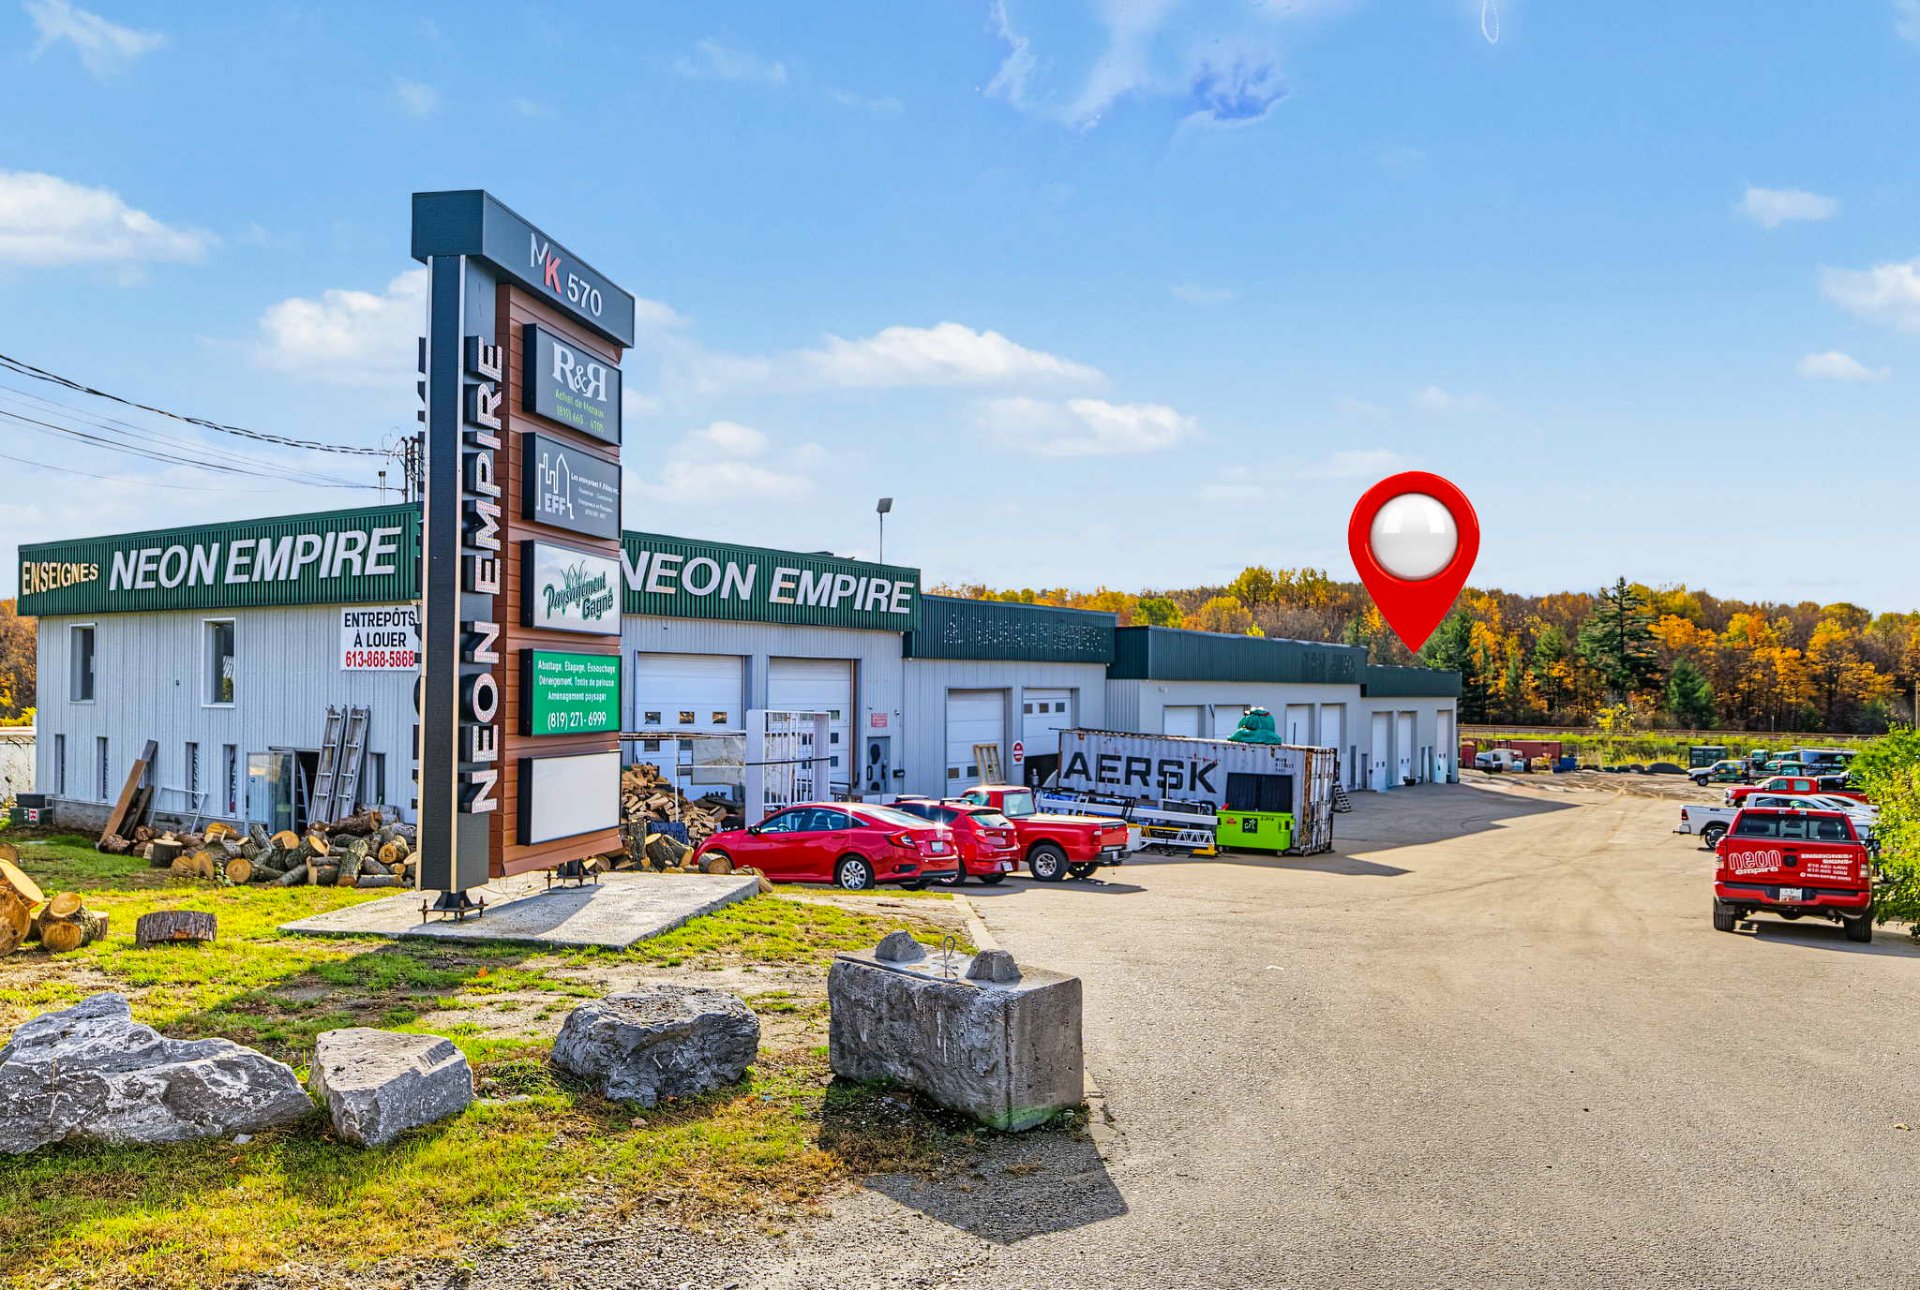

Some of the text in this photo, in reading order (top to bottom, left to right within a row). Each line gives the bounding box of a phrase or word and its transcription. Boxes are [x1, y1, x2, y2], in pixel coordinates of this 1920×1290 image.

[567, 273, 602, 317] 570
[544, 493, 566, 515] EFF
[22, 527, 402, 596] ENSEIGNES NEON EMPIRE
[472, 335, 502, 814] NEON EMPIRE
[620, 549, 914, 614] NEON EMPIRE
[344, 607, 415, 627] ENTREPÔTS
[582, 587, 614, 621] Gagné
[354, 629, 407, 648] À LOUER
[345, 651, 415, 668] 613-868-5868
[547, 712, 568, 731] (819)
[1063, 751, 1218, 794] AERSK
[1729, 849, 1782, 870] neon
